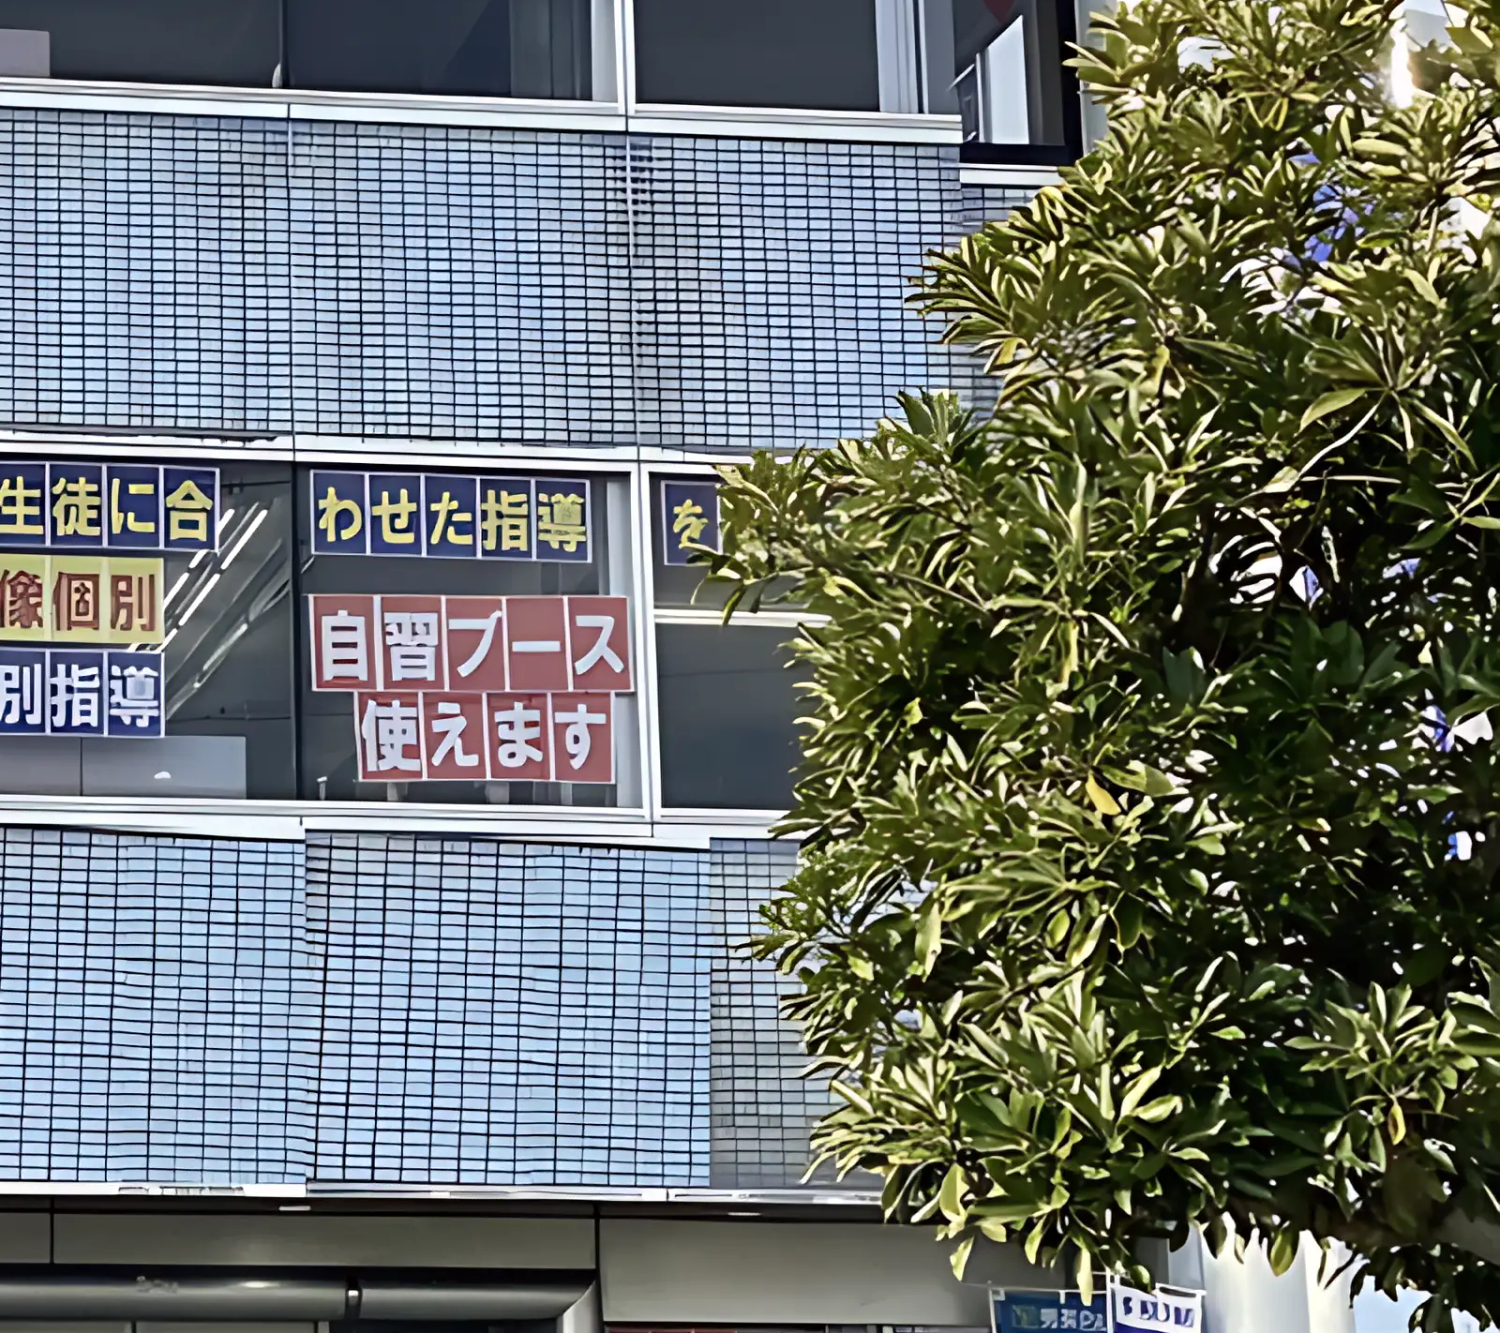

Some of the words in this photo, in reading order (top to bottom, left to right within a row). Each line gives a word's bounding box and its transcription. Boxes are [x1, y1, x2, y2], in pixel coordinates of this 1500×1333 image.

[317, 487, 588, 554] わせた指導
[320, 609, 626, 682] 自習ブース
[361, 699, 606, 772] 使えます
